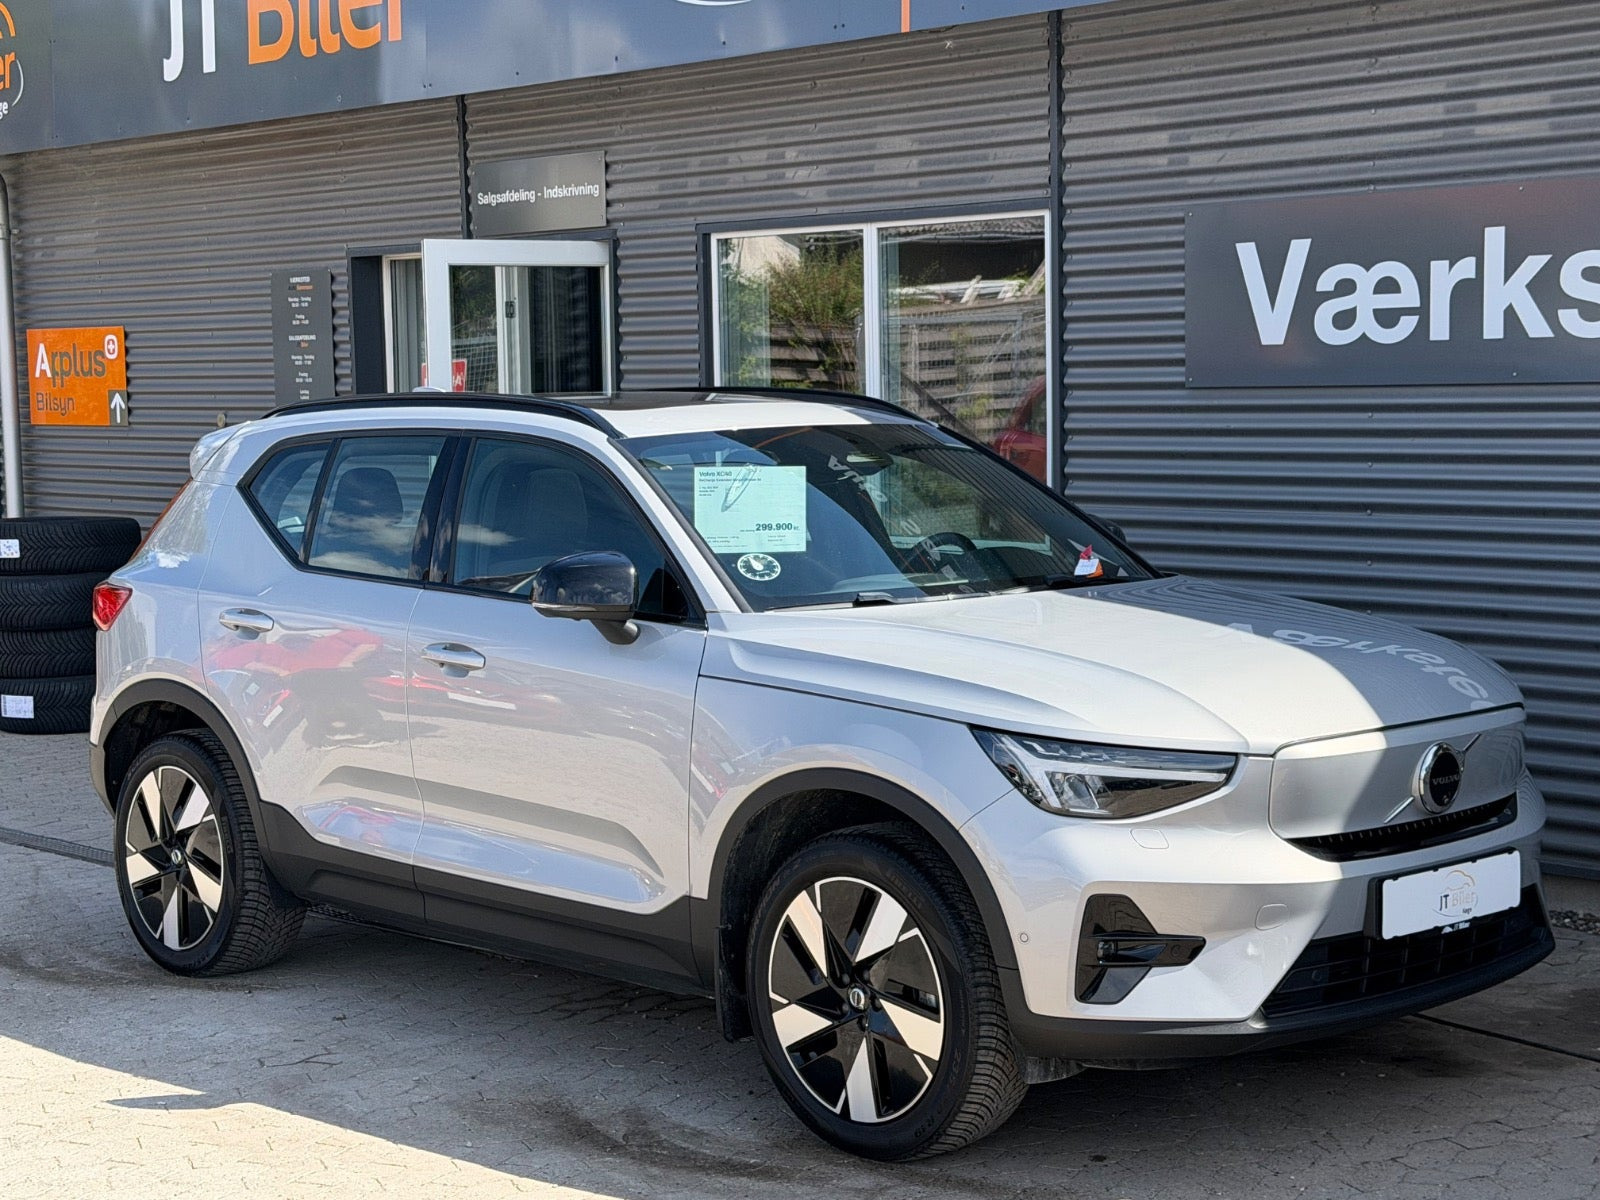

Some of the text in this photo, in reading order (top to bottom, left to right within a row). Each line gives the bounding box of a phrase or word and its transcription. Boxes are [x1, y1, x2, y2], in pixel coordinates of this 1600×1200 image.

[477, 188, 536, 206] Salgsafdeling
[543, 182, 600, 199] Indskrivning
[1235, 226, 1600, 346] Værks
[36, 392, 75, 416] Bilsyn
[755, 522, 793, 532] 299.900
[1432, 774, 1460, 785] VOLVO
[1439, 894, 1450, 911] JT
